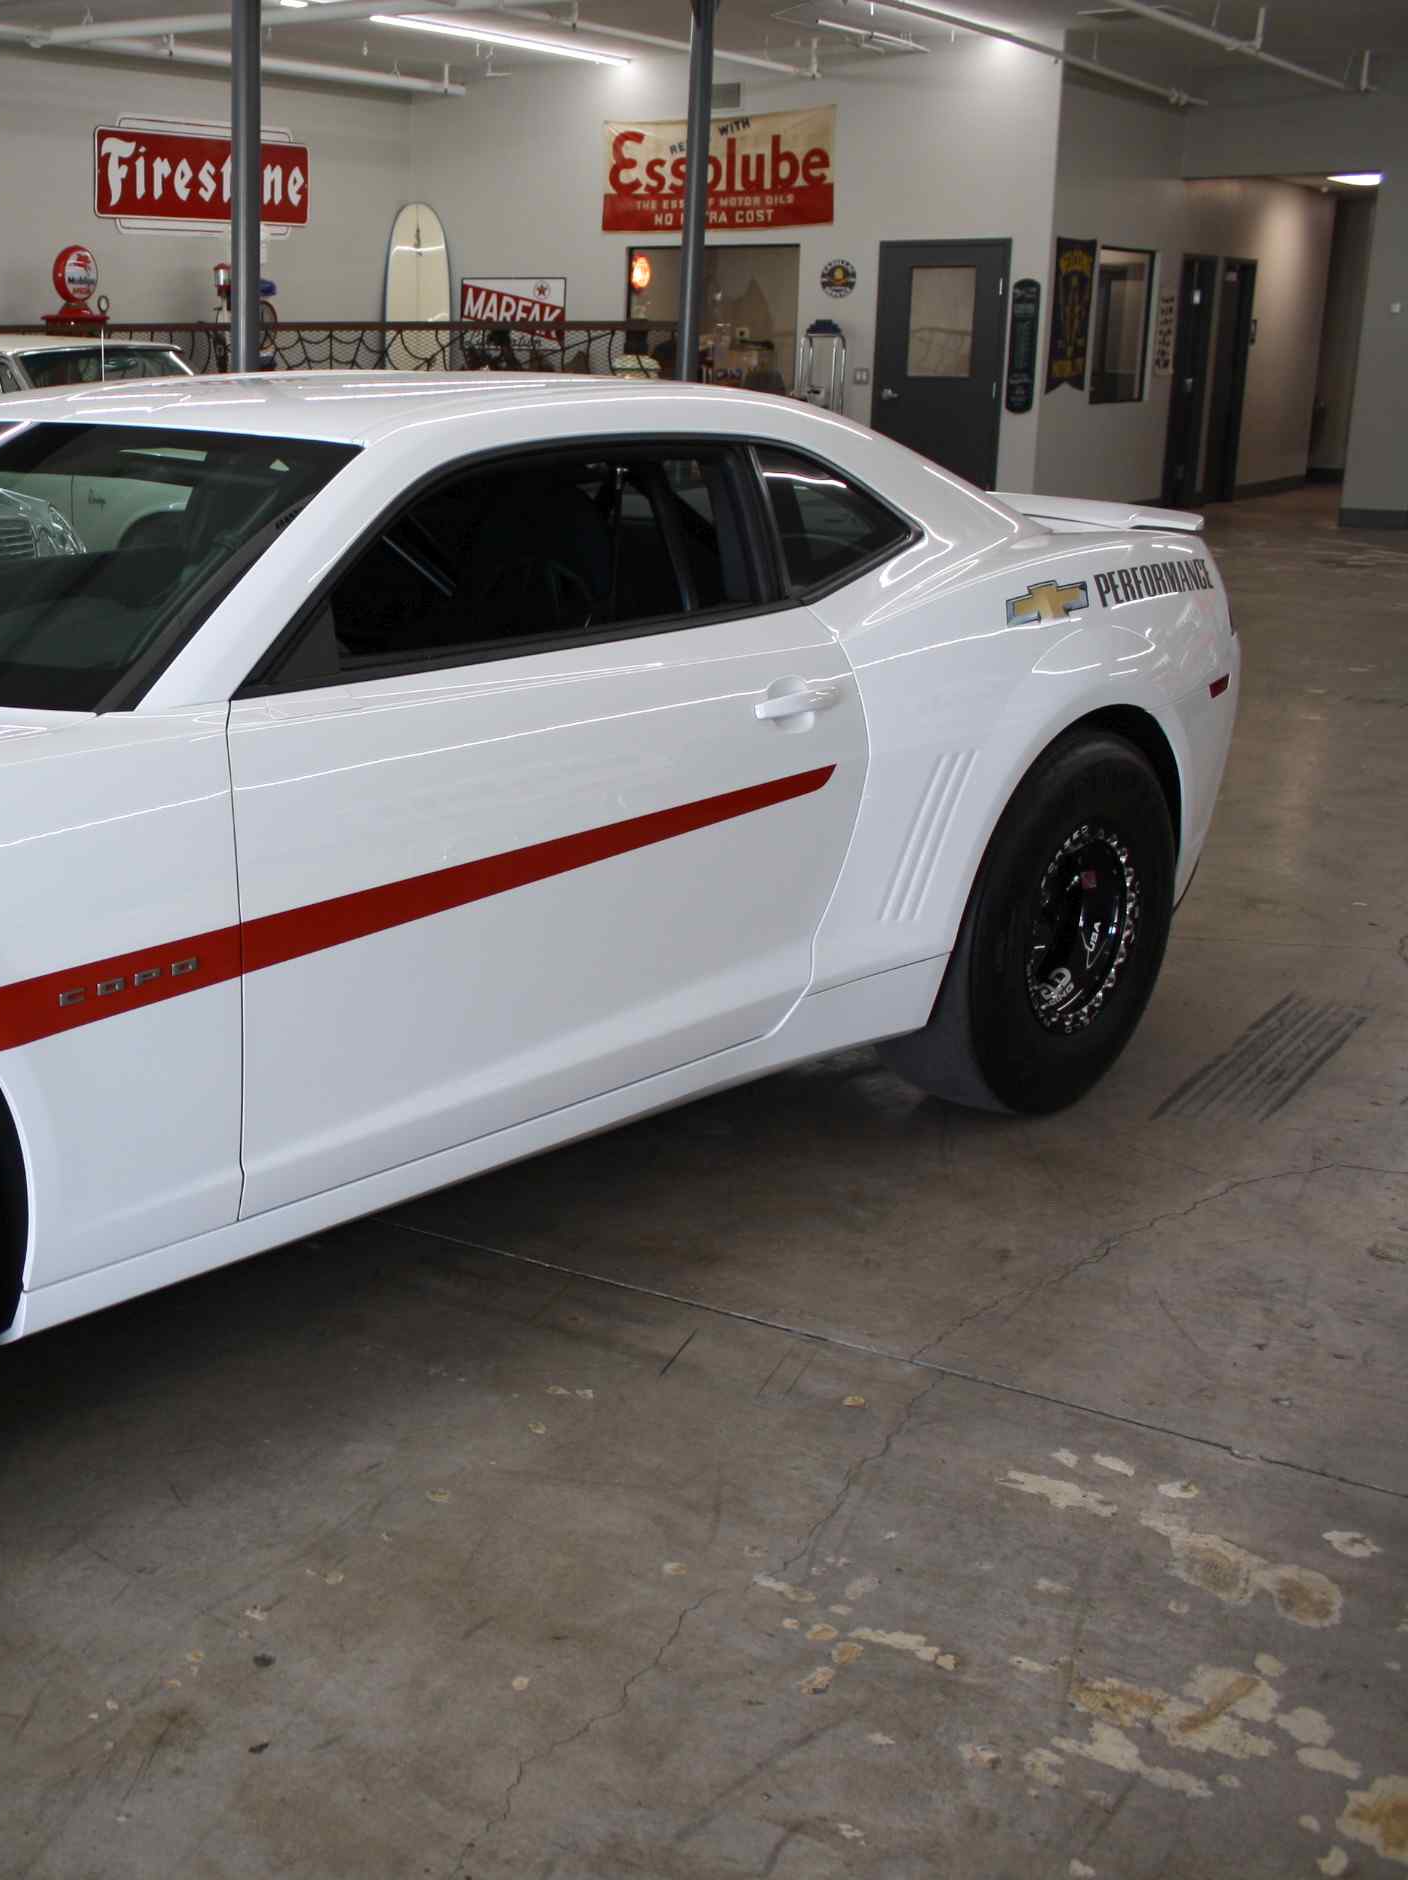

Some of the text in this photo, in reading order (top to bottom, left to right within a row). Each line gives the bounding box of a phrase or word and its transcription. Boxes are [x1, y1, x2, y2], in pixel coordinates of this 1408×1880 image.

[718, 117, 751, 136] WITH
[101, 137, 305, 207] Firestne
[654, 212, 673, 225] NO
[735, 209, 774, 223] COST
[720, 195, 761, 207] MOTOR
[765, 194, 795, 205] OILS
[463, 287, 562, 338] MARFAK
[1093, 558, 1213, 608] PERFORMANCE
[59, 956, 198, 1007] COPO
